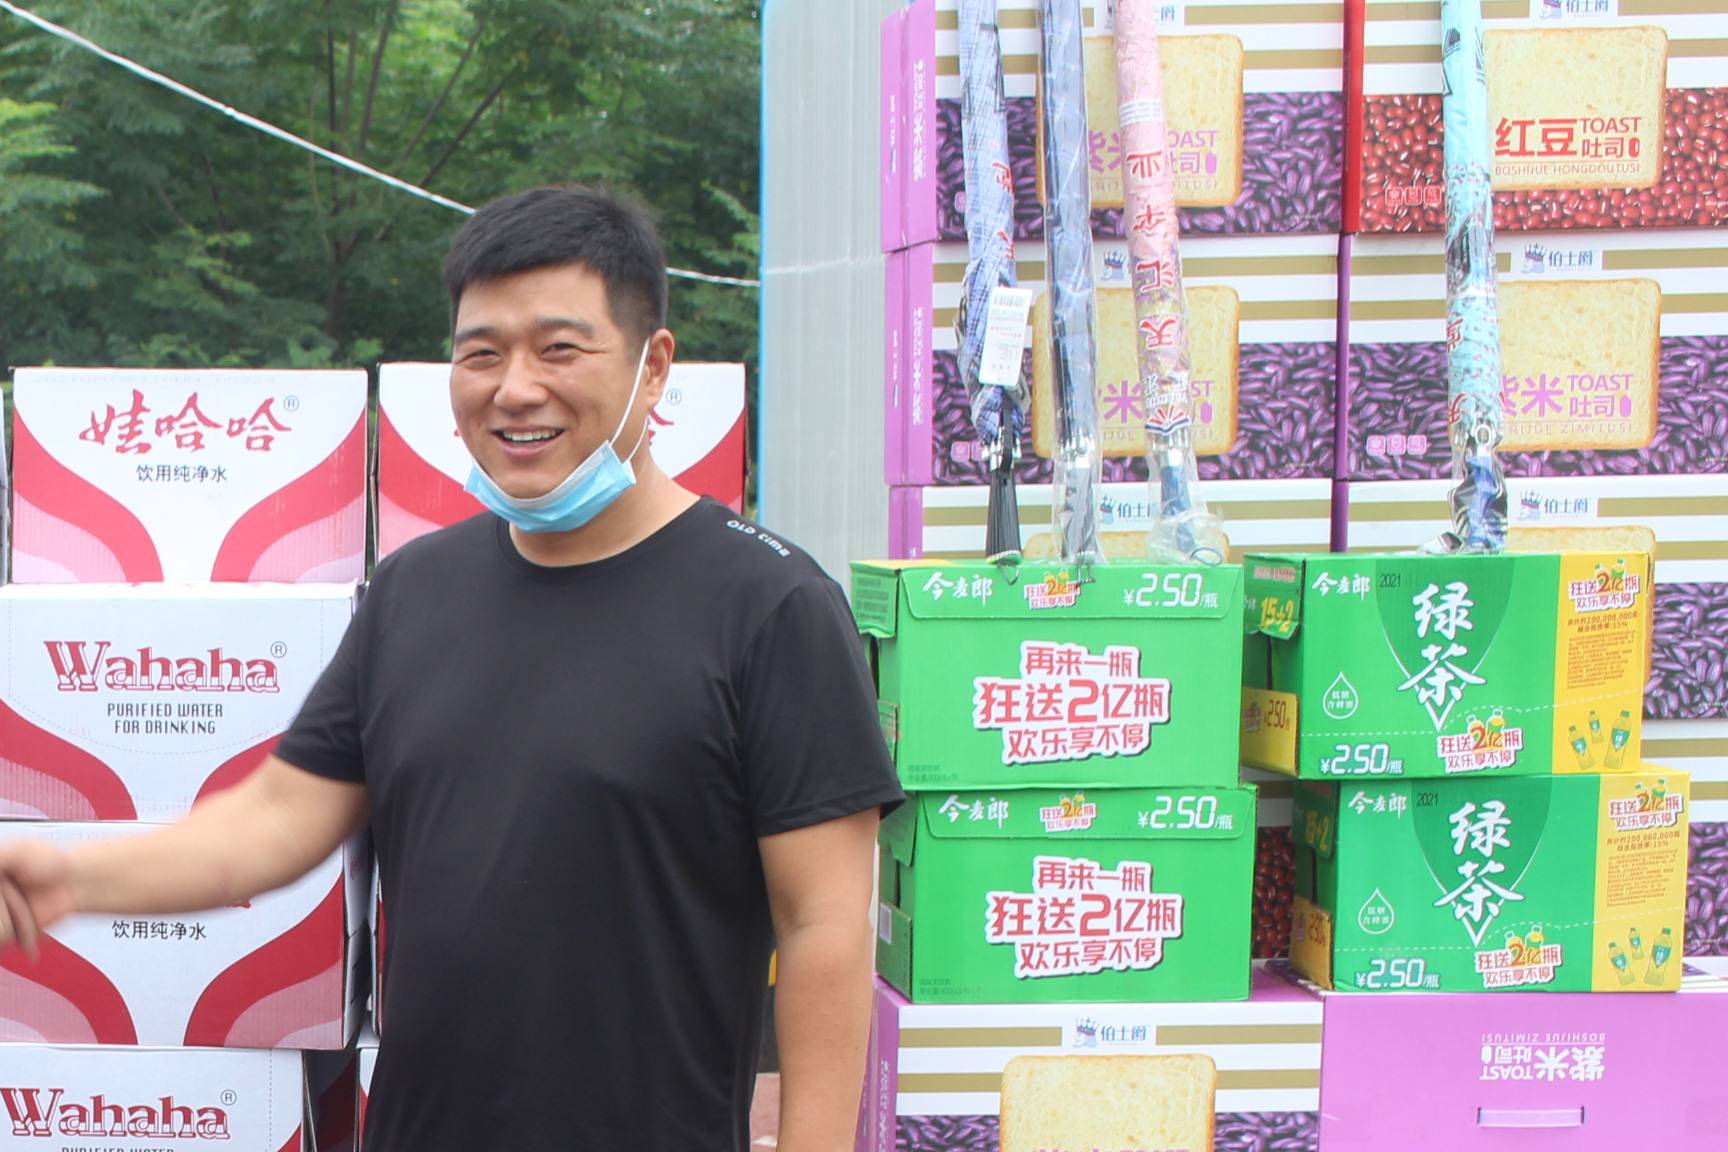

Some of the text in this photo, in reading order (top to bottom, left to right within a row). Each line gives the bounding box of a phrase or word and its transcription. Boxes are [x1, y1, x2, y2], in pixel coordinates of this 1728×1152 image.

[1495, 117, 1578, 158] 红豆
[1580, 117, 1641, 133] TOAST
[1581, 137, 1625, 158] 吐司
[1495, 163, 1640, 176] BOSHIJUE HONGDOUTUSI
[1568, 374, 1634, 391] TOAST
[1569, 396, 1618, 417] 吐司
[80, 389, 291, 456] 娃哈哈
[136, 464, 227, 484] 饮用纯净水
[923, 572, 992, 606] 今麦郎
[1312, 572, 1369, 600] 今麦郎
[1380, 574, 1401, 587] 2021
[1570, 573, 1639, 596] 狂送2亿瓶
[1398, 581, 1487, 706] 绿茶
[44, 640, 280, 694] Wahaha
[1026, 647, 1132, 676] 再来一瓶
[108, 702, 223, 718] PURIFIED WATER
[979, 680, 1164, 721] 狂送2亿瓶
[114, 719, 215, 735] FOR DRINKING
[1439, 723, 1521, 751] 狂送2亿瓶
[1008, 727, 1149, 757] 欢乐享不停
[939, 795, 1009, 829] 今麦郎
[1348, 792, 1407, 818] 今麦郎
[1417, 793, 1438, 806] 2021
[1611, 788, 1682, 815] 狂送2亿瓶
[1435, 800, 1524, 923] 绿茶
[1038, 861, 1144, 890] 再来一瓶
[991, 894, 1177, 935] 狂送2亿瓶
[111, 921, 206, 941] 饮用纯净水
[1020, 940, 1161, 970] 欢乐享不停
[1477, 943, 1561, 969] 狂送2亿瓶
[1100, 1026, 1147, 1042] 伯士爵
[1495, 1047, 1532, 1065] 吐司
[1535, 1047, 1605, 1082] 紫米
[1479, 1065, 1533, 1080] TOAST
